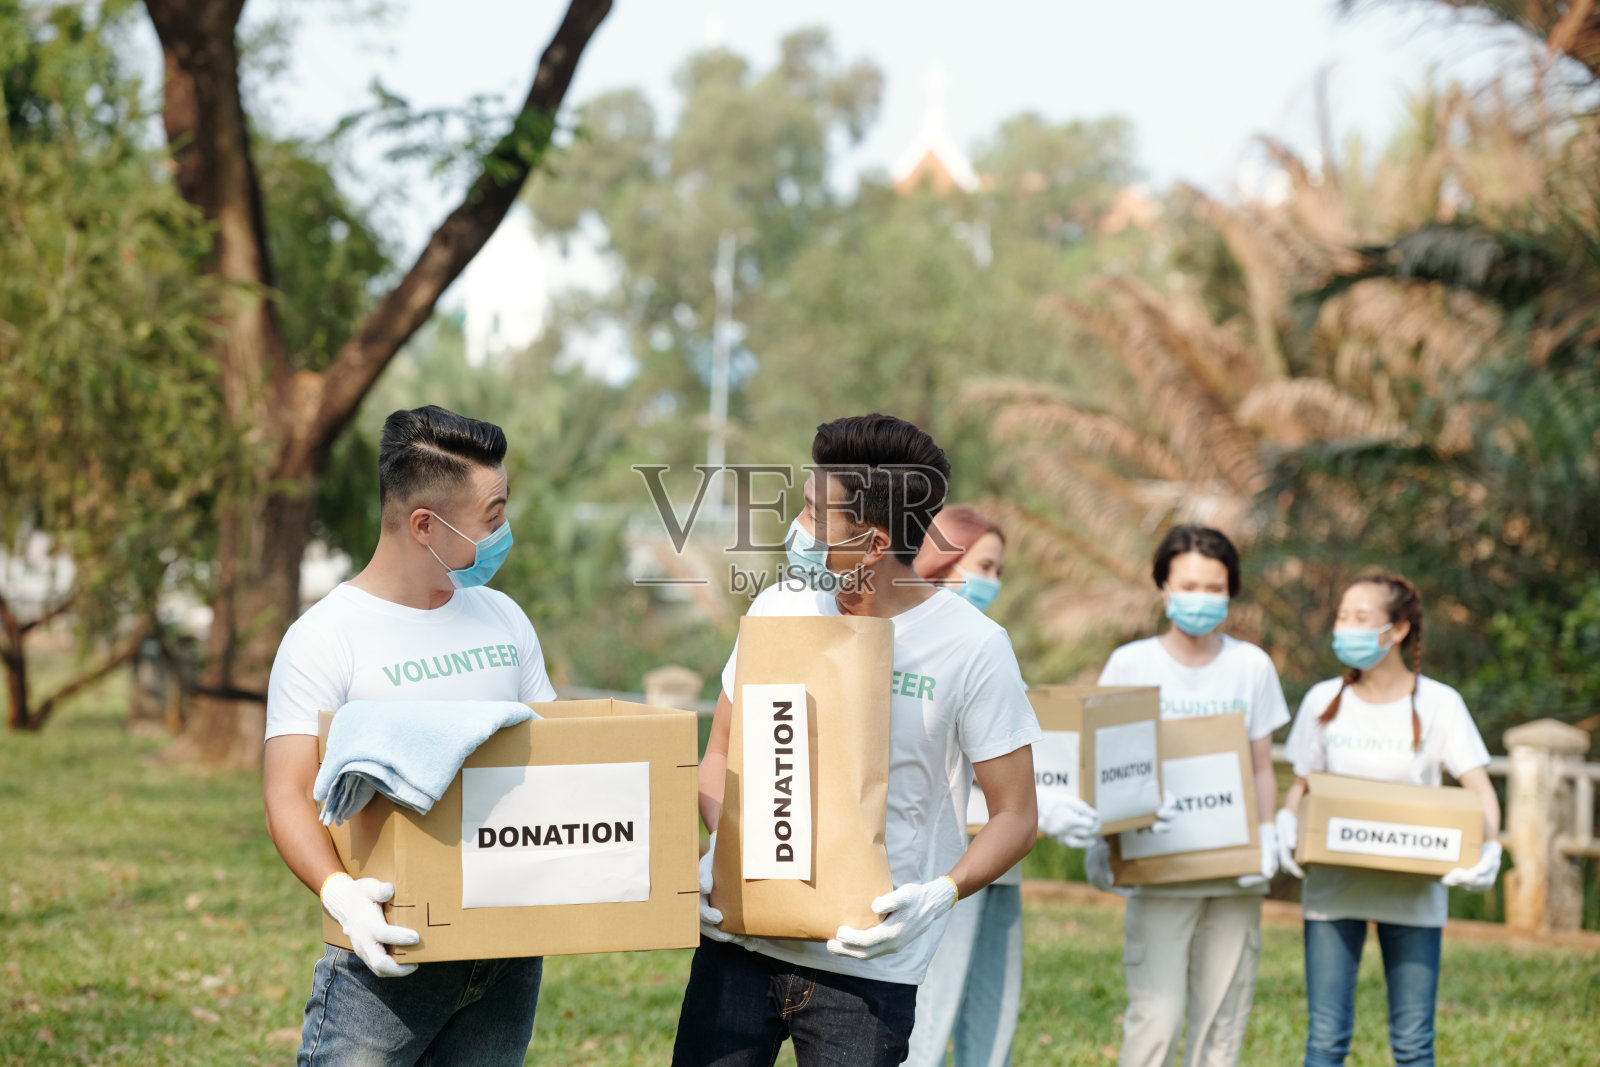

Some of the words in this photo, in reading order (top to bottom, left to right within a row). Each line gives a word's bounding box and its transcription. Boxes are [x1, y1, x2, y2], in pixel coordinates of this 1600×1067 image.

[382, 644, 520, 687] VOLUNTEER
[773, 701, 794, 862] DONATION
[1101, 760, 1153, 785] DONATION
[478, 821, 634, 849] DONATION
[1340, 826, 1449, 849] DONATION
